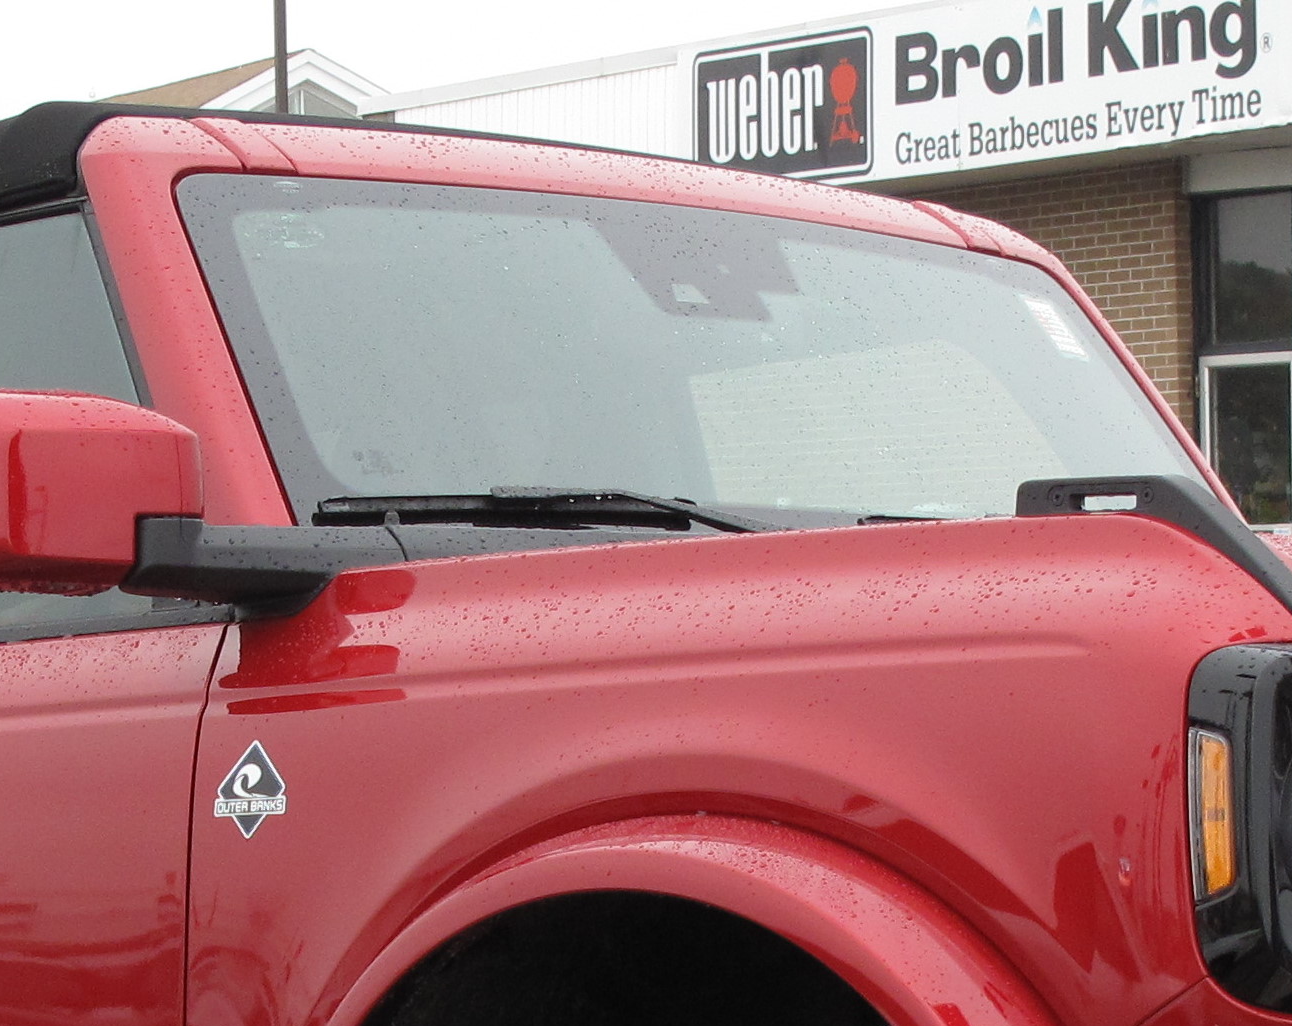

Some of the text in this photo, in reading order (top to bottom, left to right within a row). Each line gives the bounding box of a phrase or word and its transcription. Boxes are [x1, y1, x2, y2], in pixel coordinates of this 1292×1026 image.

[895, 0, 1257, 105] Broil King
[706, 52, 823, 163] weber
[896, 86, 1262, 165] Great Barbecues Every Time
[217, 799, 284, 813] OUTER BANKS
